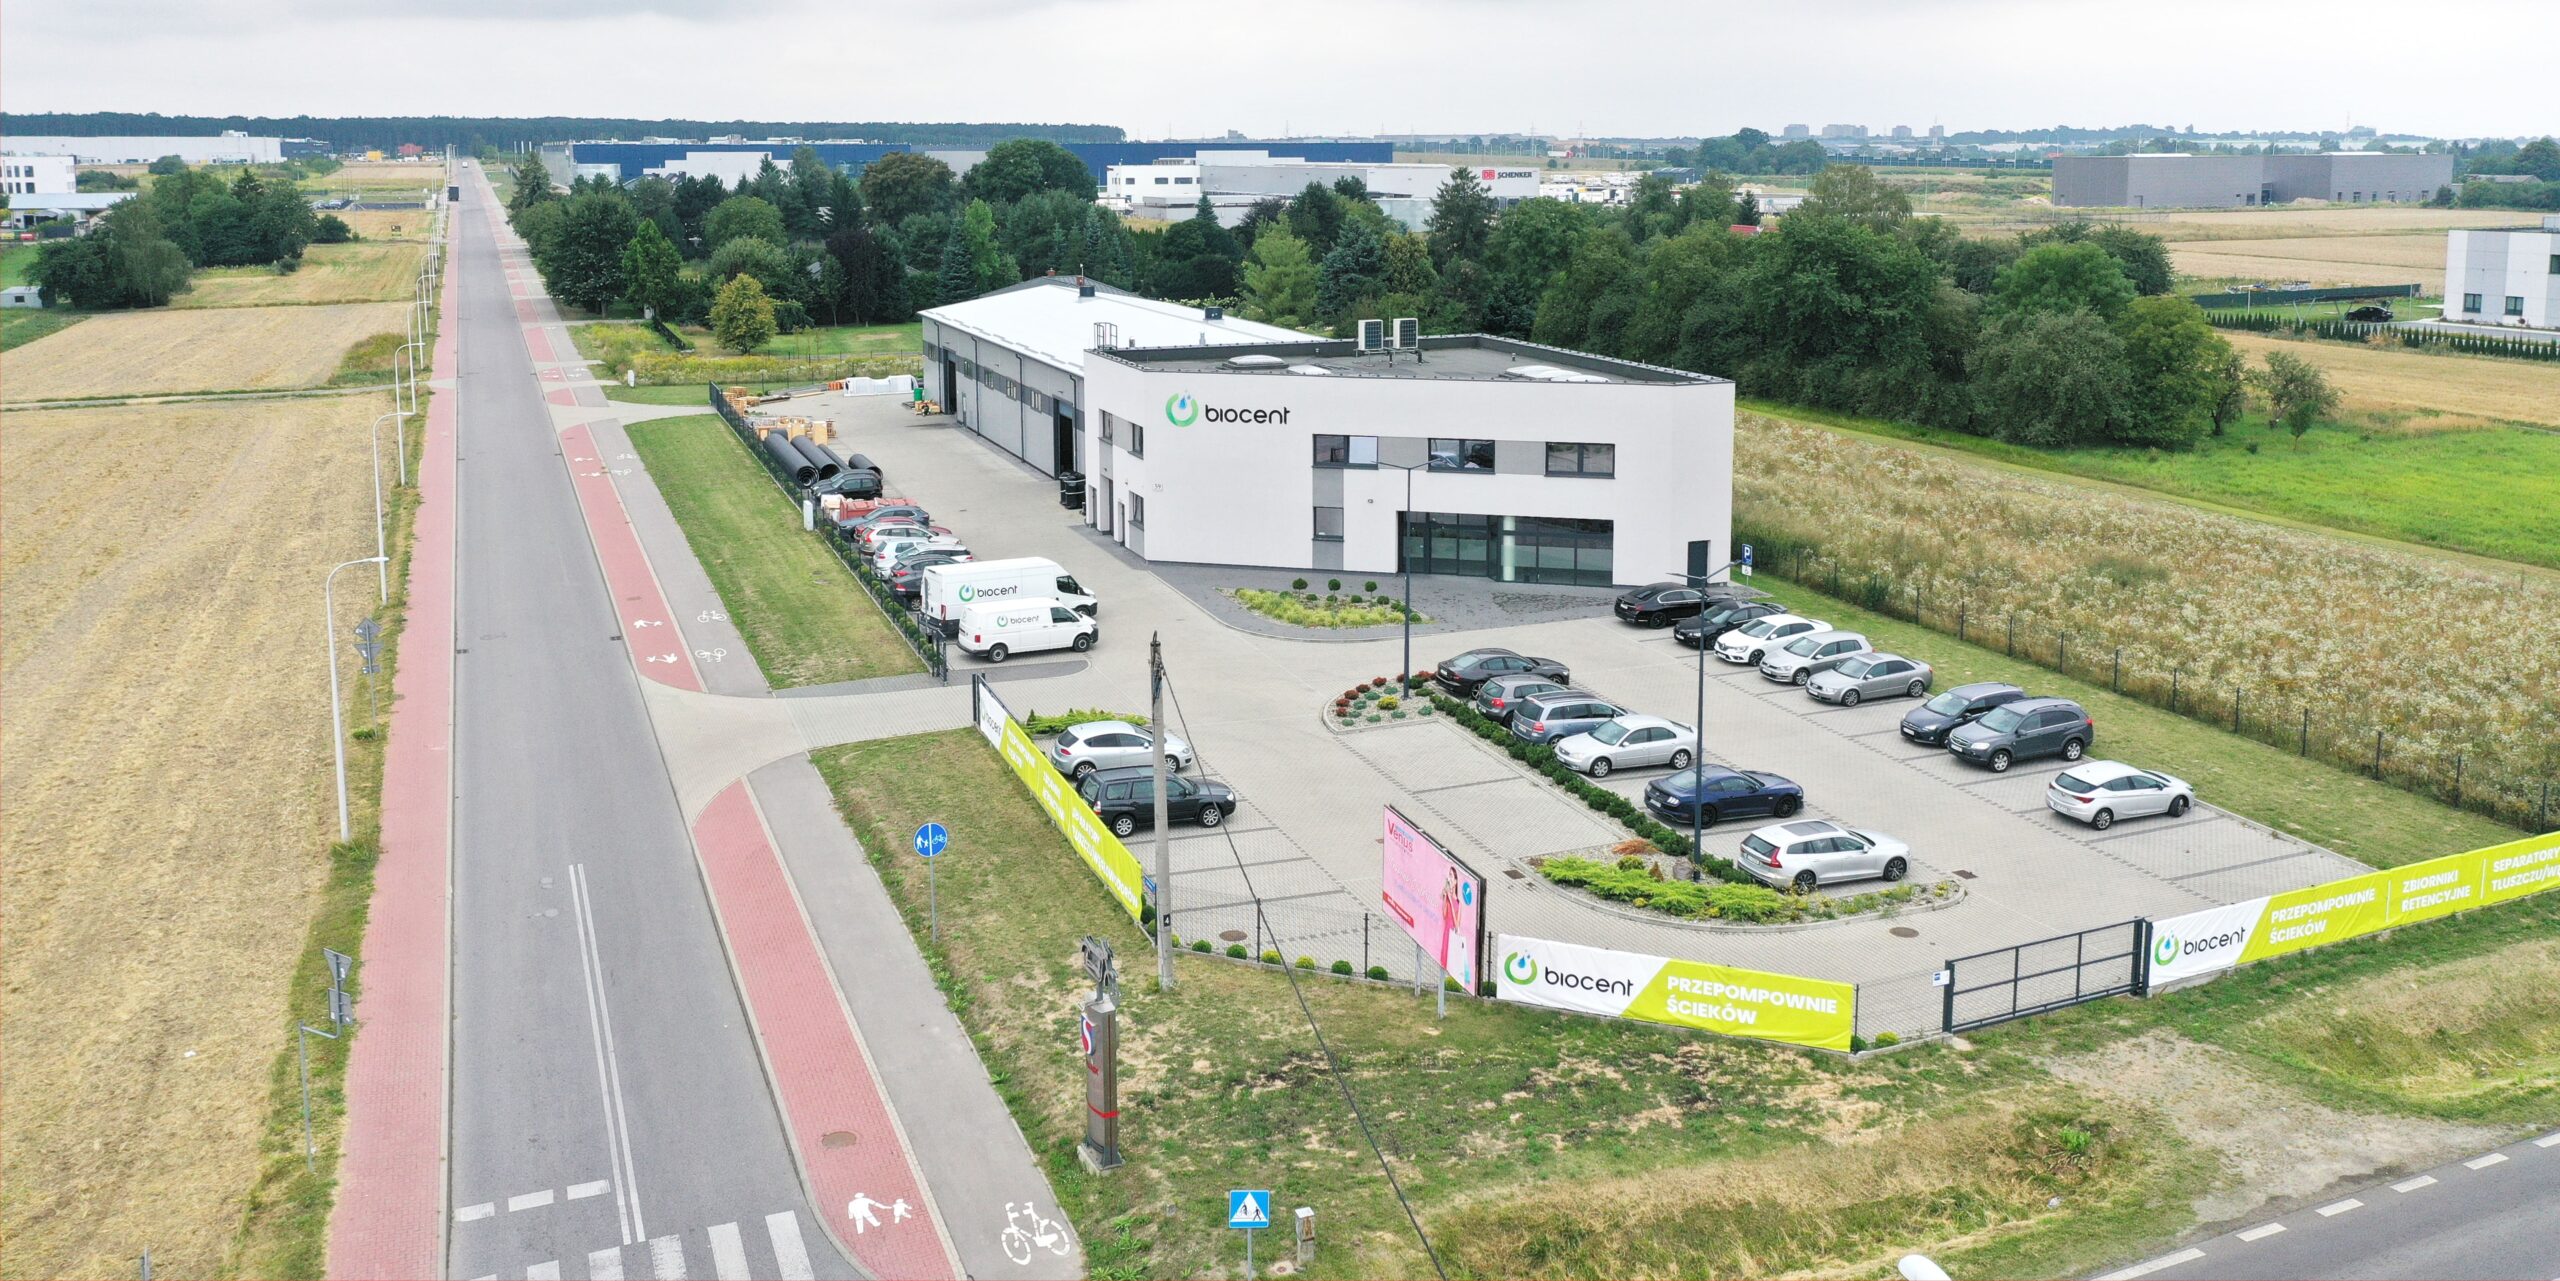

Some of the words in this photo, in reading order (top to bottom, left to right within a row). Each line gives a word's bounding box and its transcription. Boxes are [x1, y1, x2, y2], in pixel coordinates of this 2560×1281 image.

[1497, 171, 1532, 179] SCHENKER
[1205, 404, 1291, 425] biocent
[1744, 546, 1751, 559] P
[977, 585, 1018, 598] biocent
[1010, 615, 1040, 625] biocent
[1387, 818, 1414, 853] Venus
[2493, 846, 2560, 872] SEPARATORY
[2402, 870, 2459, 894] ZBIORNIKI
[2271, 888, 2376, 924] PRZEPOMPOWNIE
[2402, 885, 2471, 913] RETENCYJNE
[2184, 927, 2246, 955] biocent
[2269, 919, 2327, 945] ŚCIEKÓW
[1545, 966, 1634, 997] biocent
[1667, 975, 1838, 1015] PRZEPOMPOWNIE
[1666, 998, 1758, 1025] ŚCIEKÓW
